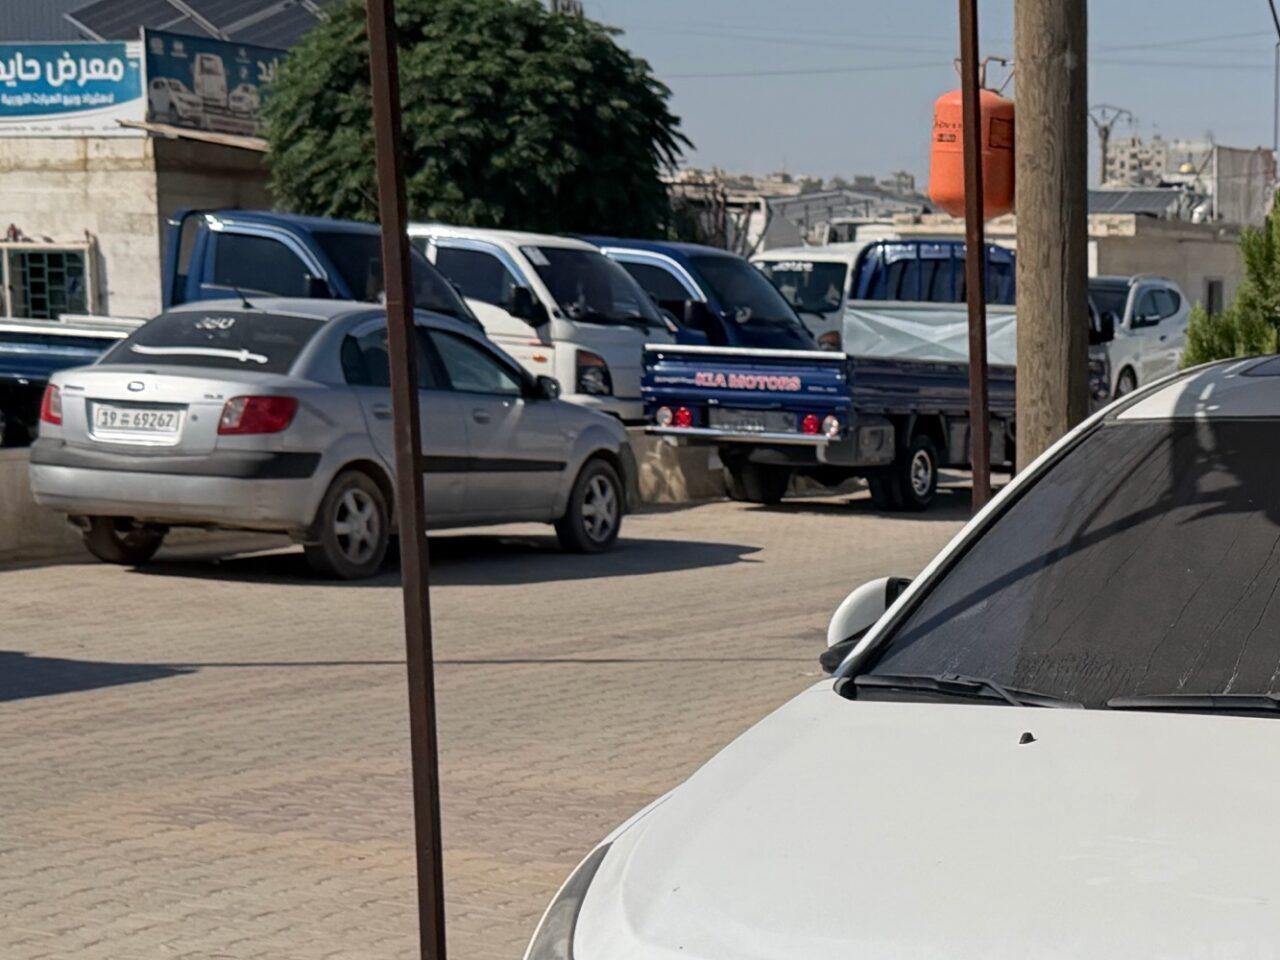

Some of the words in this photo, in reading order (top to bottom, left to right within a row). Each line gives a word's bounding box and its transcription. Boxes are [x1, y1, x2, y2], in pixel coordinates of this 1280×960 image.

[45, 51, 124, 87] معرض
[695, 372, 727, 388] KIA
[728, 374, 802, 391] MOTORS
[133, 412, 174, 427] 69267
